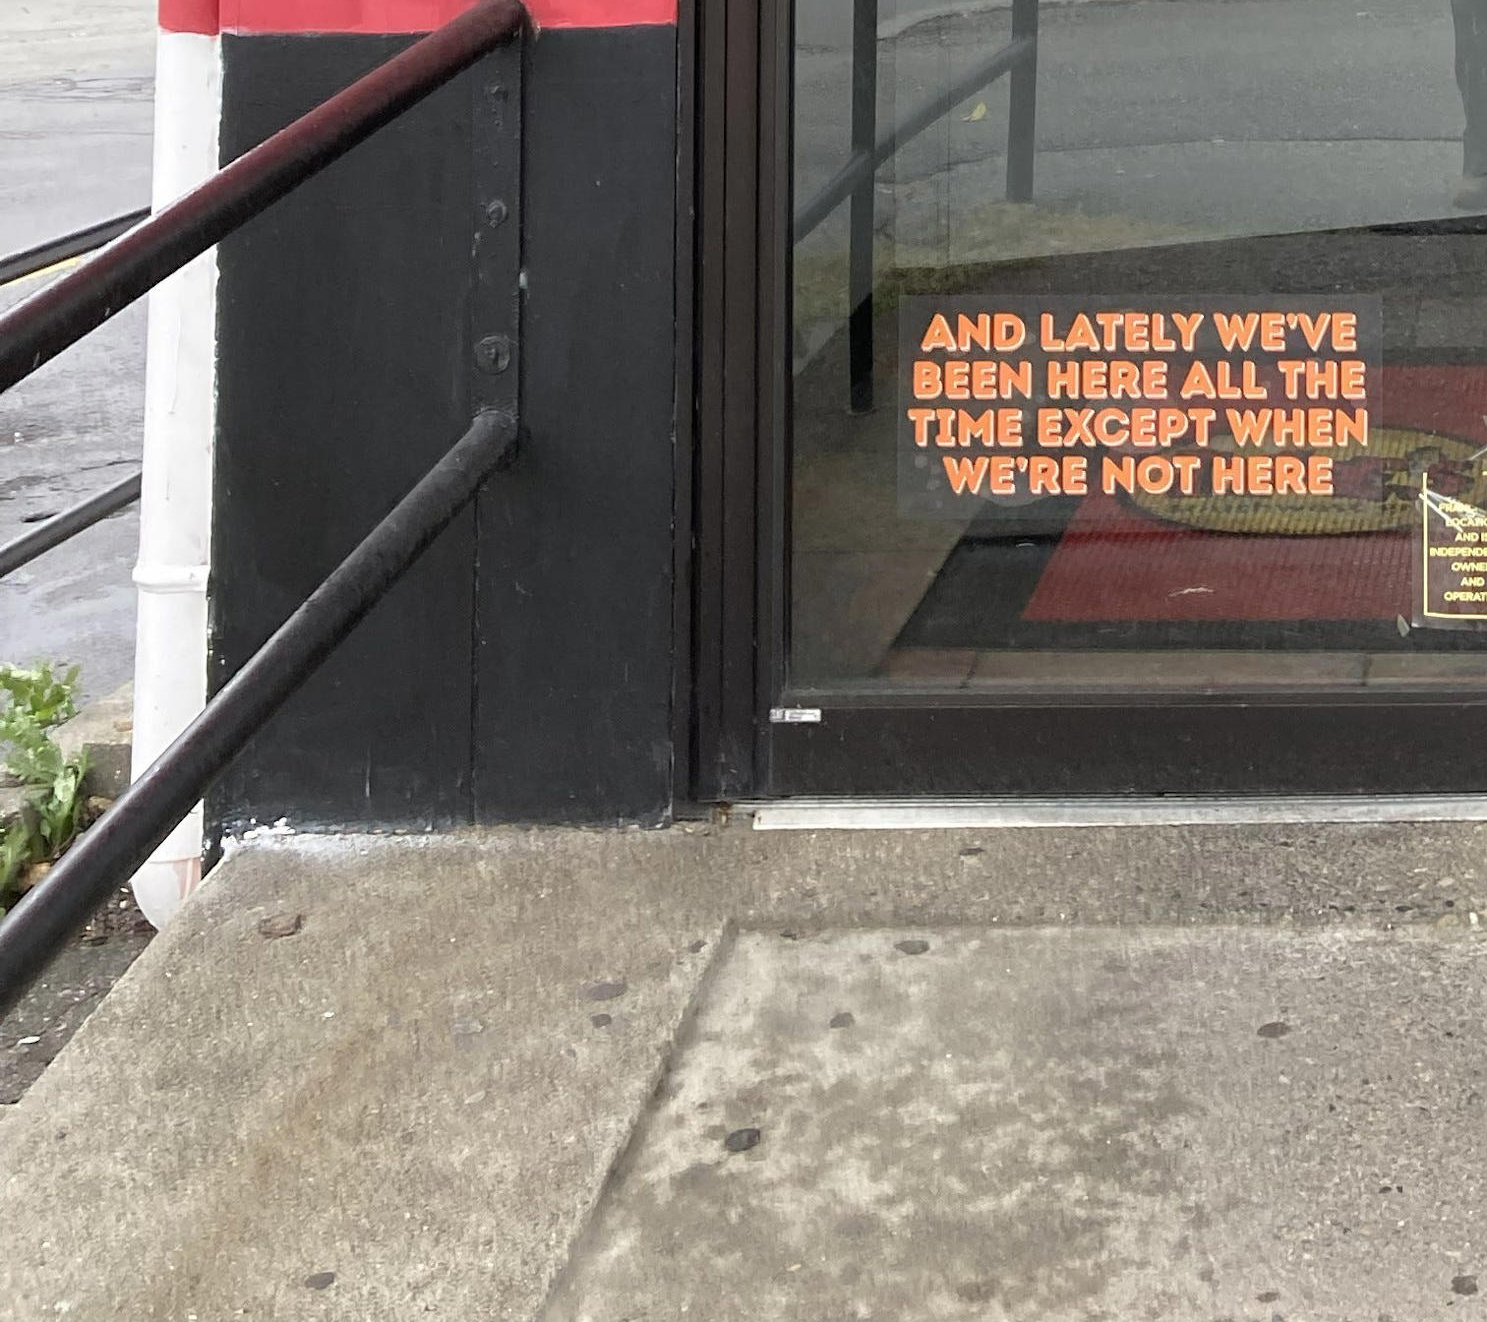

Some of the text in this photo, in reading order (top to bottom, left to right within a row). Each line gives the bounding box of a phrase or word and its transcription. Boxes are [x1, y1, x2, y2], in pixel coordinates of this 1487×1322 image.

[921, 313, 1356, 352] AND LATELY WE'VE
[913, 360, 1366, 399] BEEN HERE ALL THE
[908, 408, 1367, 447] TIME EXCEPT WHEN
[943, 456, 1334, 495] WE'RE NOT HERE
[1455, 532, 1479, 542] AND
[1460, 577, 1485, 586] AND
